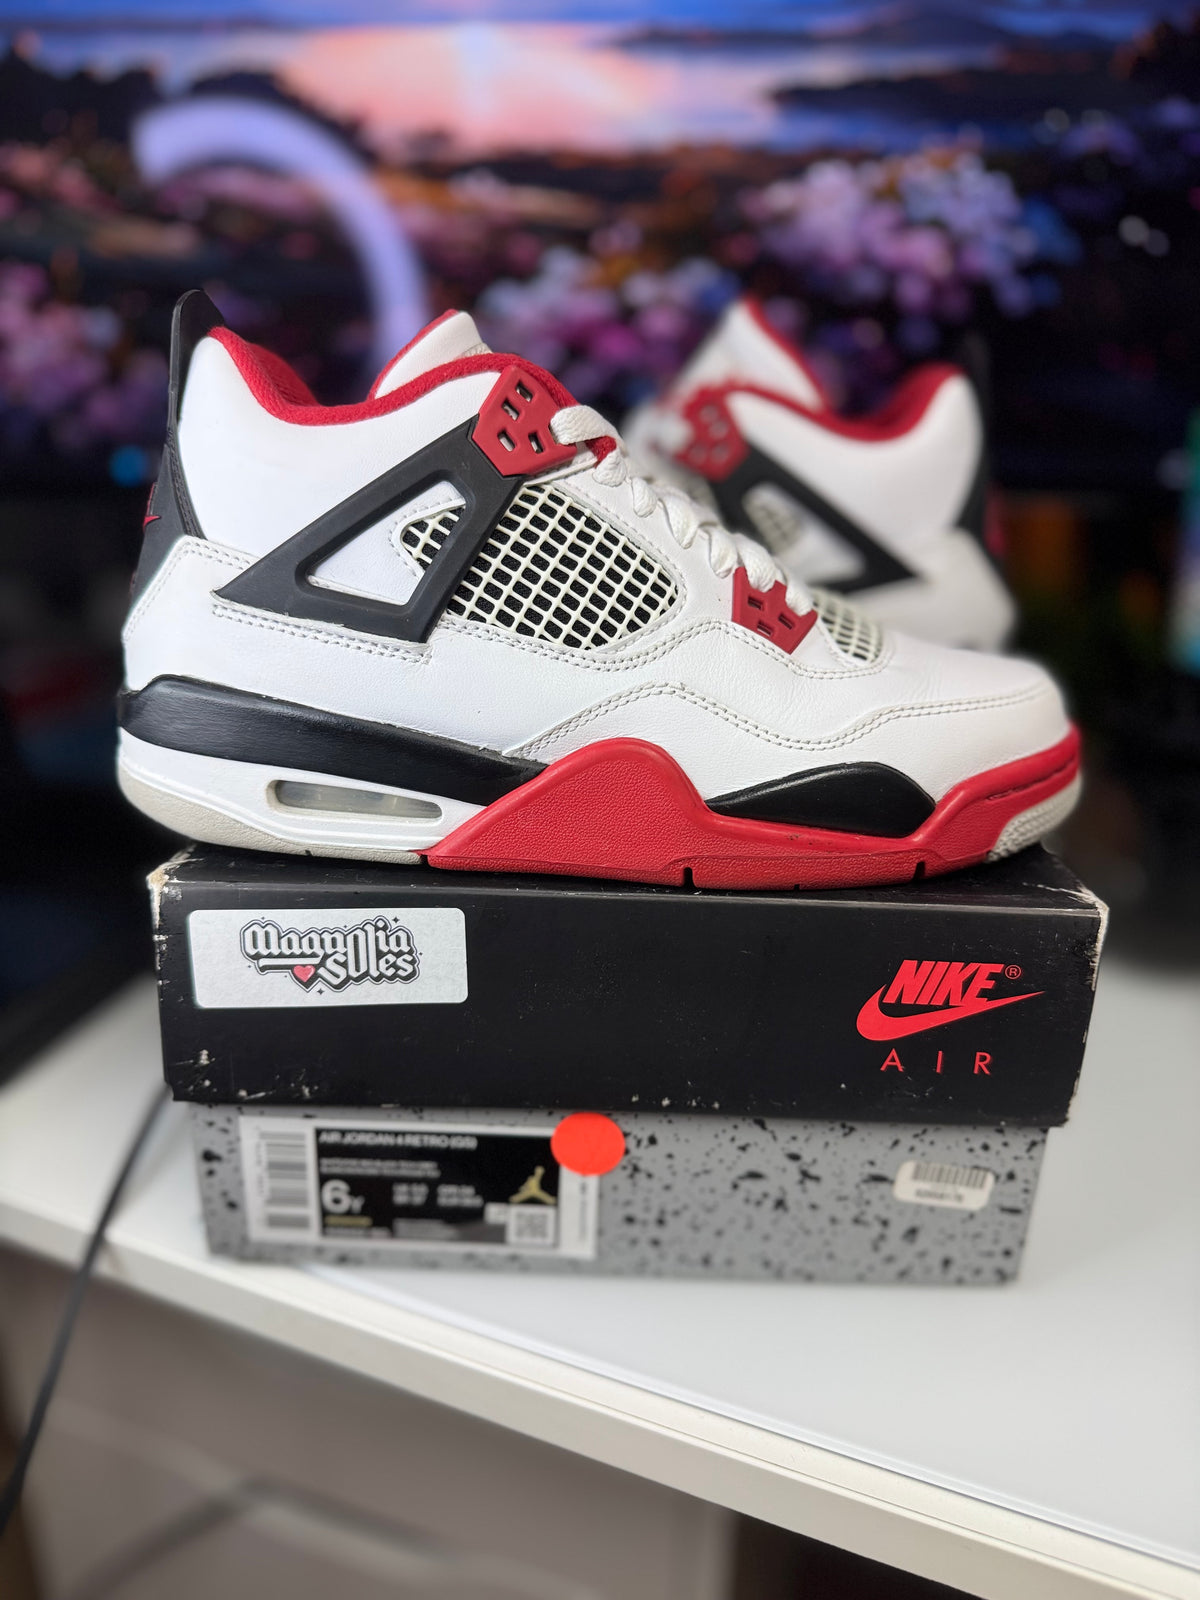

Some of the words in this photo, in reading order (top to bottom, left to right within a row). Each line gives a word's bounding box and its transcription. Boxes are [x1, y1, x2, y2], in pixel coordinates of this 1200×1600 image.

[241, 915, 414, 968] Magnolia
[880, 1048, 993, 1075] AIR
[319, 1131, 342, 1144] AIR
[343, 1131, 395, 1146] JORDAN
[404, 1134, 449, 1148] RETRO
